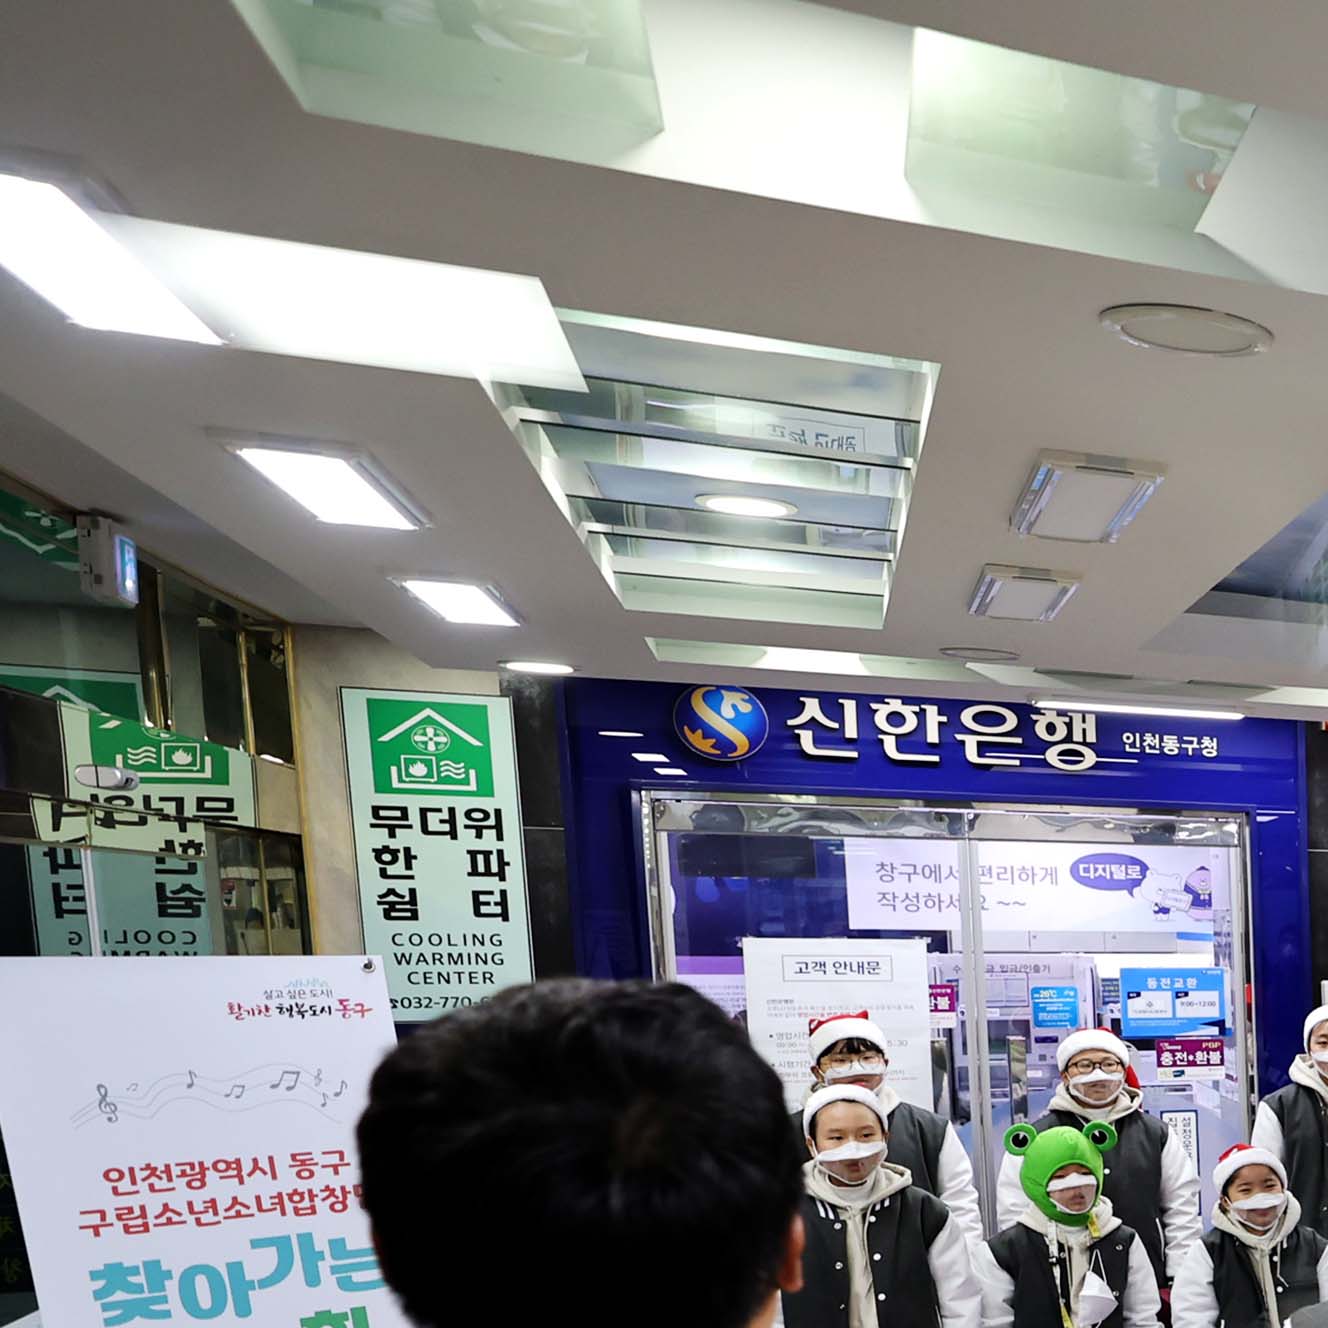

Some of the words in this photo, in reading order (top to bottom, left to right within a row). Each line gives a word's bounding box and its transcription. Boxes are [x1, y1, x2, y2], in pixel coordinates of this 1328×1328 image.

[786, 696, 1099, 772] 신한은행
[1121, 731, 1219, 758] 인천동구청
[369, 804, 505, 842] 무더위
[976, 864, 1059, 887] 편리하게
[1078, 862, 1144, 881] 디지털로
[391, 932, 504, 948] COOLING
[393, 951, 505, 967] WARMING
[794, 960, 827, 976] 고객
[832, 959, 882, 976] 안내문
[407, 970, 496, 986] CENTER
[227, 1001, 272, 1021] 활기찬
[335, 998, 374, 1020] 동구
[102, 1154, 279, 1198] 인천광역시
[288, 1148, 352, 1181] 동구
[89, 1231, 389, 1328] 찾아가는
